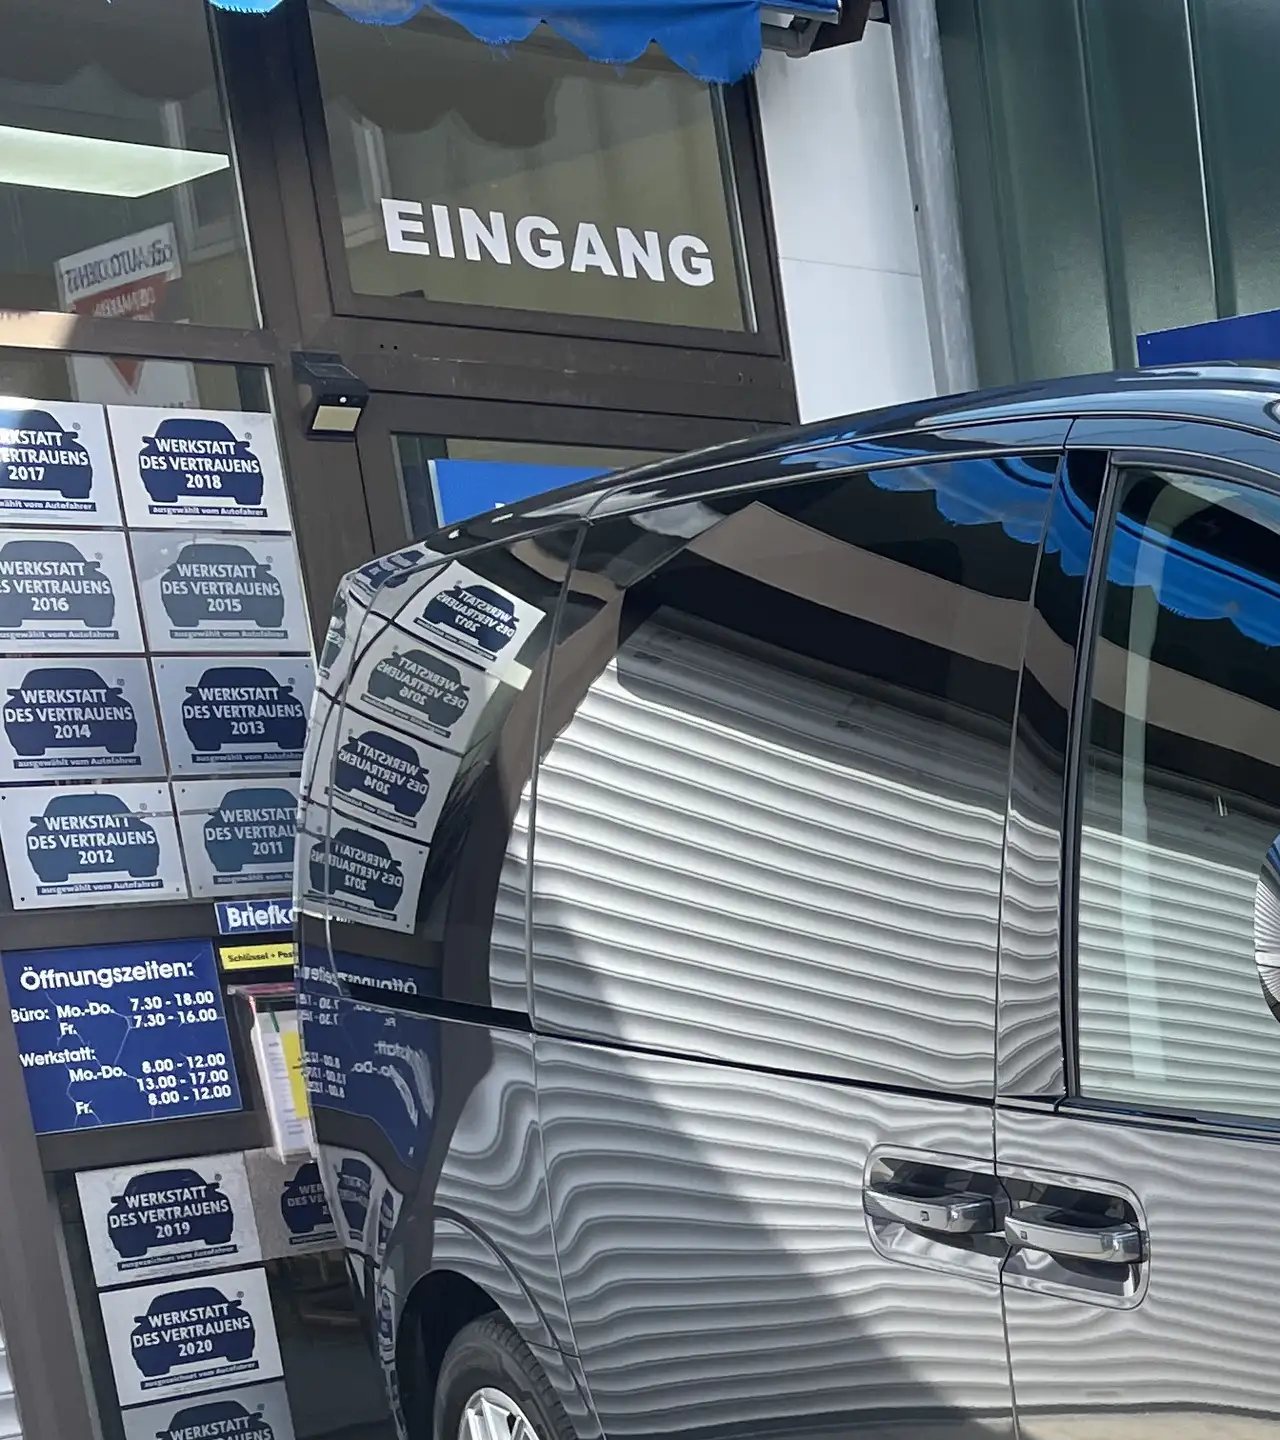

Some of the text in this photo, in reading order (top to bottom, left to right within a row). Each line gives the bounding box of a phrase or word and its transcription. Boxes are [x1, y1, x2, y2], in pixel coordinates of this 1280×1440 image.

[381, 198, 715, 287] EINGANG
[155, 438, 235, 455] WERKSTATT
[0, 447, 89, 465] ERTRAUENS
[140, 455, 260, 473] DES VERTRAUENS
[7, 465, 45, 481] 2017
[185, 473, 222, 489] 2018
[0, 561, 85, 576] WERKSTATT
[176, 563, 257, 578] WERKSTATT
[13, 579, 111, 595] VERTRAUENS
[162, 581, 280, 596] DES VERTRAUENS
[31, 597, 70, 612] 2016
[207, 598, 242, 612] 2015
[21, 688, 107, 704] WERKSTATT
[198, 686, 279, 701] WERKSTATT
[4, 706, 133, 722] DES VERTRAUENS
[183, 704, 303, 719] DES VERTRAUENS
[53, 724, 91, 739] 2014
[230, 721, 265, 735] 2013
[27, 830, 156, 850] DES VERTRAUENS
[205, 825, 297, 841] DES VERTRAU
[252, 841, 283, 855] 2011
[78, 850, 114, 865] 2012
[20, 960, 195, 991] Öffnungszeiten:
[10, 1006, 50, 1023] Büro:
[57, 1002, 115, 1019] Mo.-Do.
[130, 996, 163, 1012] 7.30
[176, 990, 215, 1006] 18.00
[60, 1021, 77, 1036] Fr.
[133, 1015, 166, 1029] 7.30
[179, 1008, 218, 1024] 16.00
[19, 1047, 97, 1068] Werkstatt:
[69, 1065, 127, 1083] Mo.-Do.
[141, 1059, 174, 1074] 8.00
[187, 1052, 226, 1069] 12.00
[137, 1076, 177, 1091] 13.00
[190, 1069, 229, 1085] 17.00
[75, 1101, 93, 1115] Fr.
[148, 1092, 180, 1106] 8.00
[193, 1085, 232, 1101] 12.00
[125, 1186, 207, 1208] WERKSTATT
[109, 1199, 229, 1228] DES VERTRAUENS
[155, 1221, 191, 1239] 2019
[148, 1303, 228, 1328] WERKSTATT
[132, 1315, 251, 1348] DES VERTRAUENS
[178, 1339, 213, 1357] 2020
